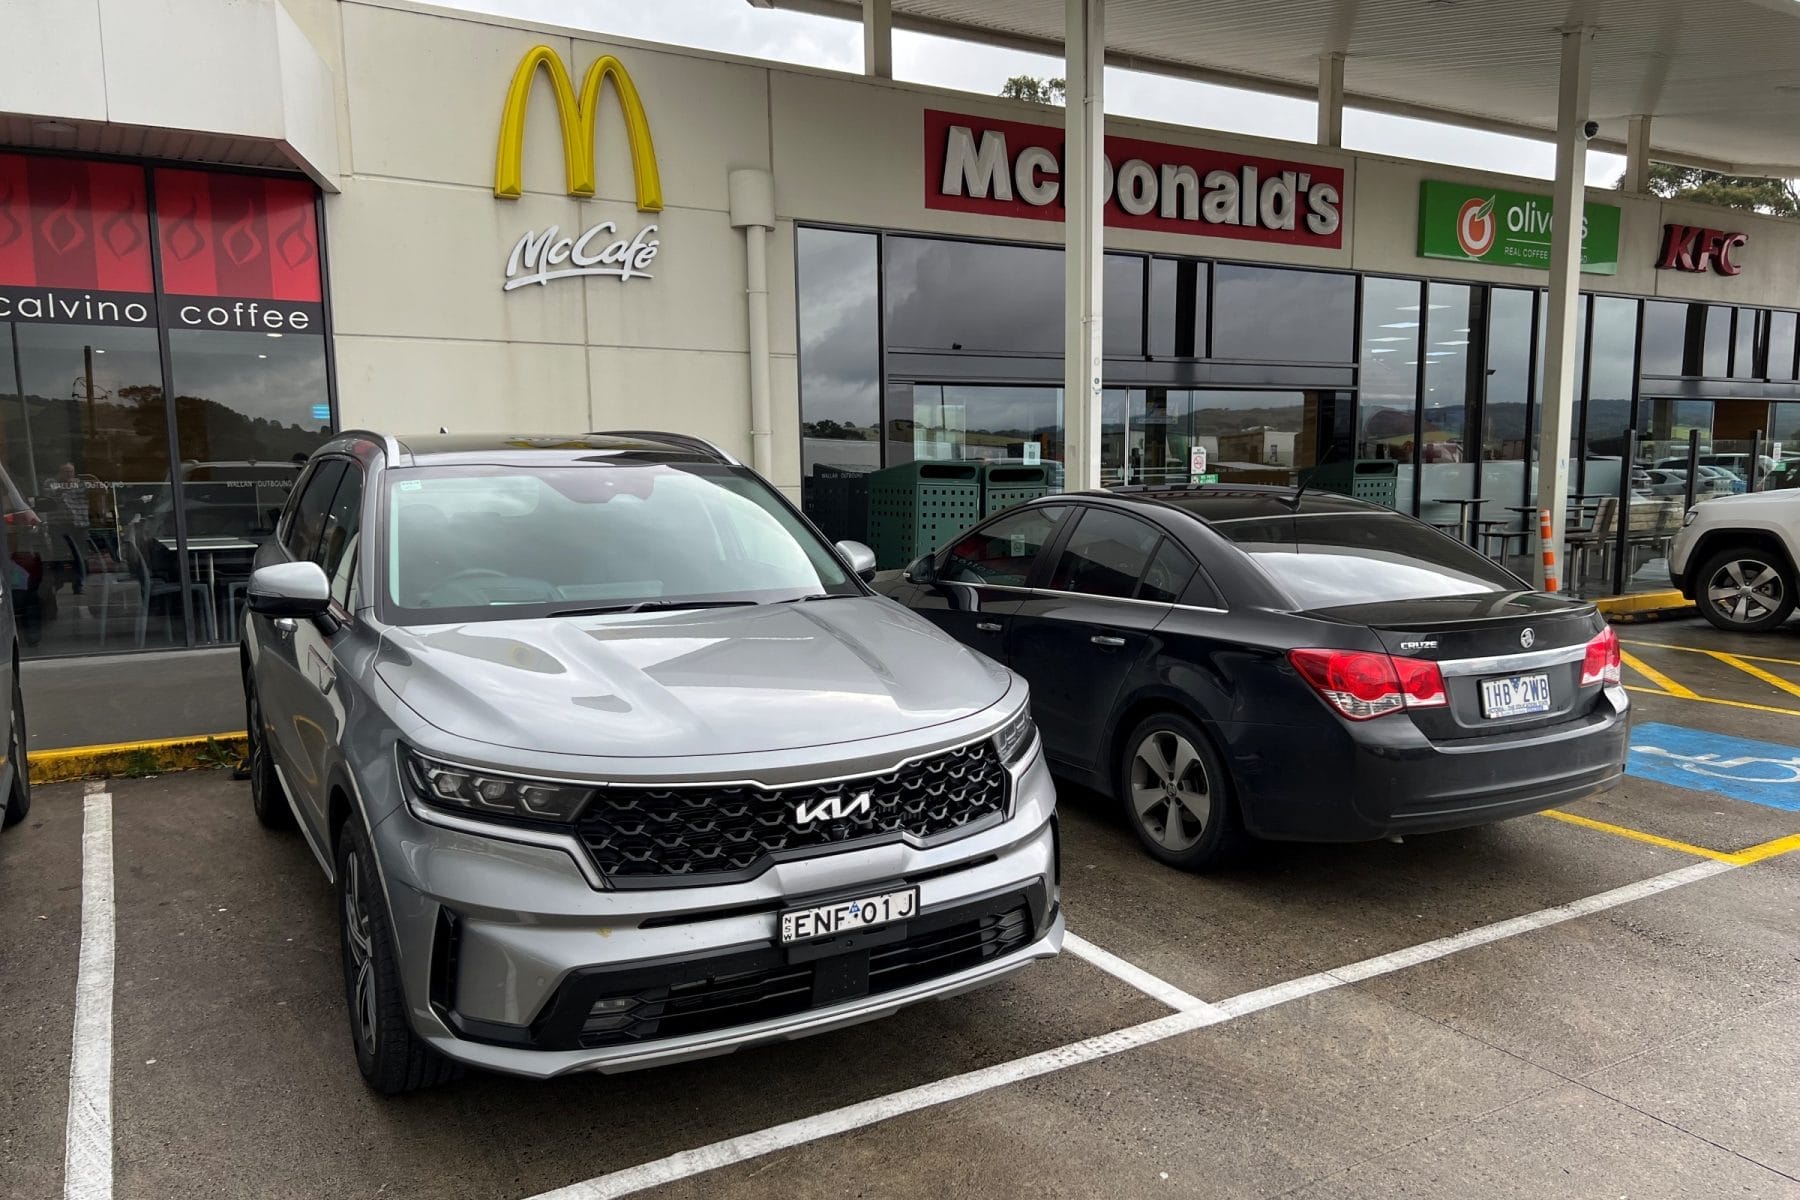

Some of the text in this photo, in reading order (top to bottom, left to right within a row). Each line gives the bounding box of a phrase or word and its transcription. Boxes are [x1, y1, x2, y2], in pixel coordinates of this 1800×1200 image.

[1507, 201, 1588, 239] olivs
[505, 222, 660, 288] McCafé
[1504, 246, 1549, 260] REAL COFFEE
[1657, 224, 1748, 276] KFC
[180, 302, 309, 329] coffee
[257, 480, 292, 488] OUTBOUND
[1400, 641, 1438, 650] CRUZE
[1485, 678, 1548, 708] 1HB 2WB
[794, 906, 850, 938] ENF
[861, 893, 913, 924] 01J
